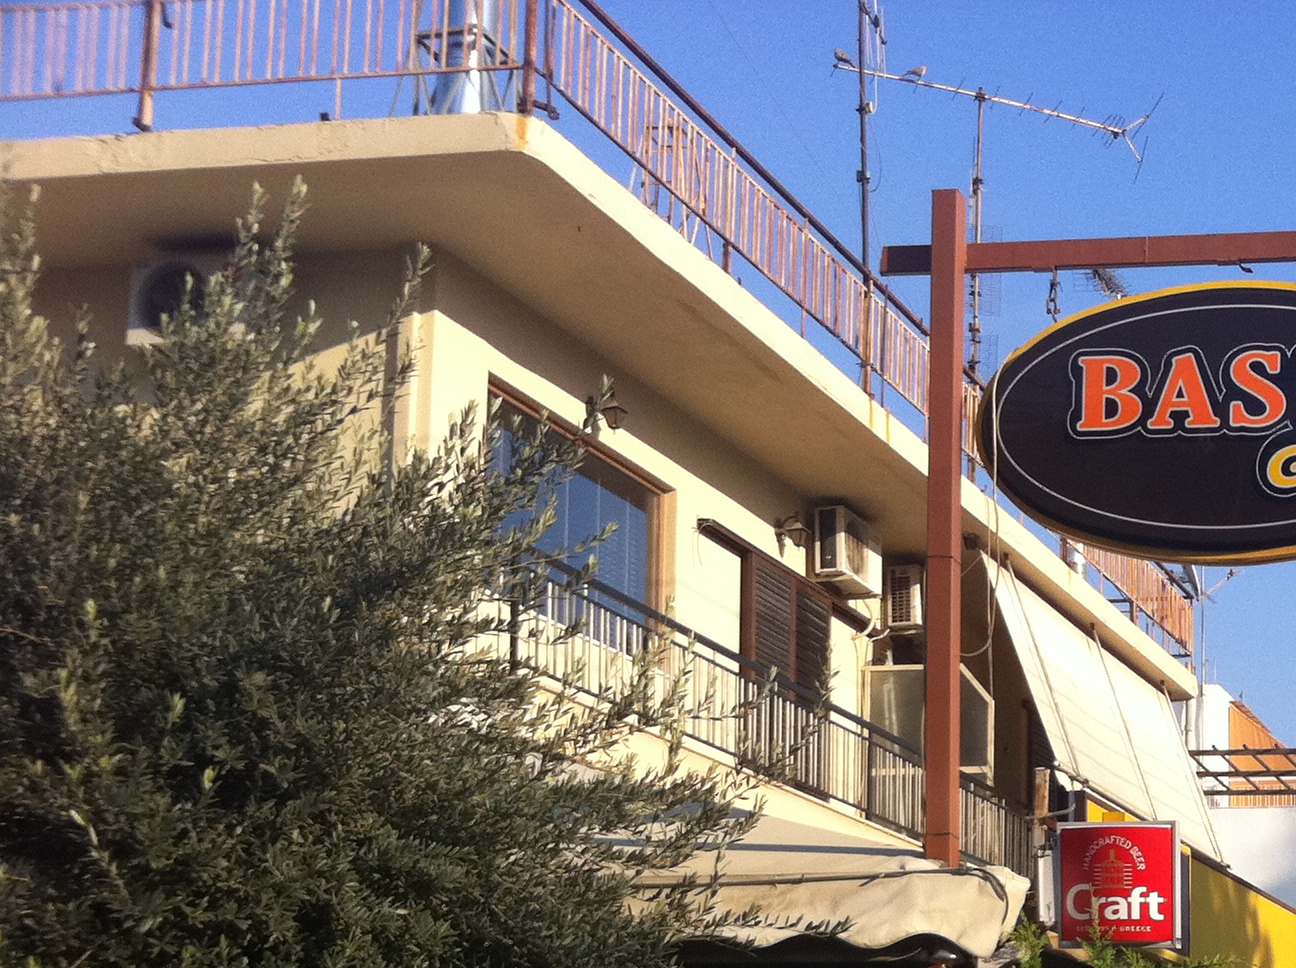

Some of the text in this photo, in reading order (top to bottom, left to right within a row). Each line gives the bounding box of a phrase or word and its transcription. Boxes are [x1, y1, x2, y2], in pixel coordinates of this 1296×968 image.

[1083, 835, 1147, 871] HANDCRAFTED BEER
[1066, 883, 1165, 921] Craft
